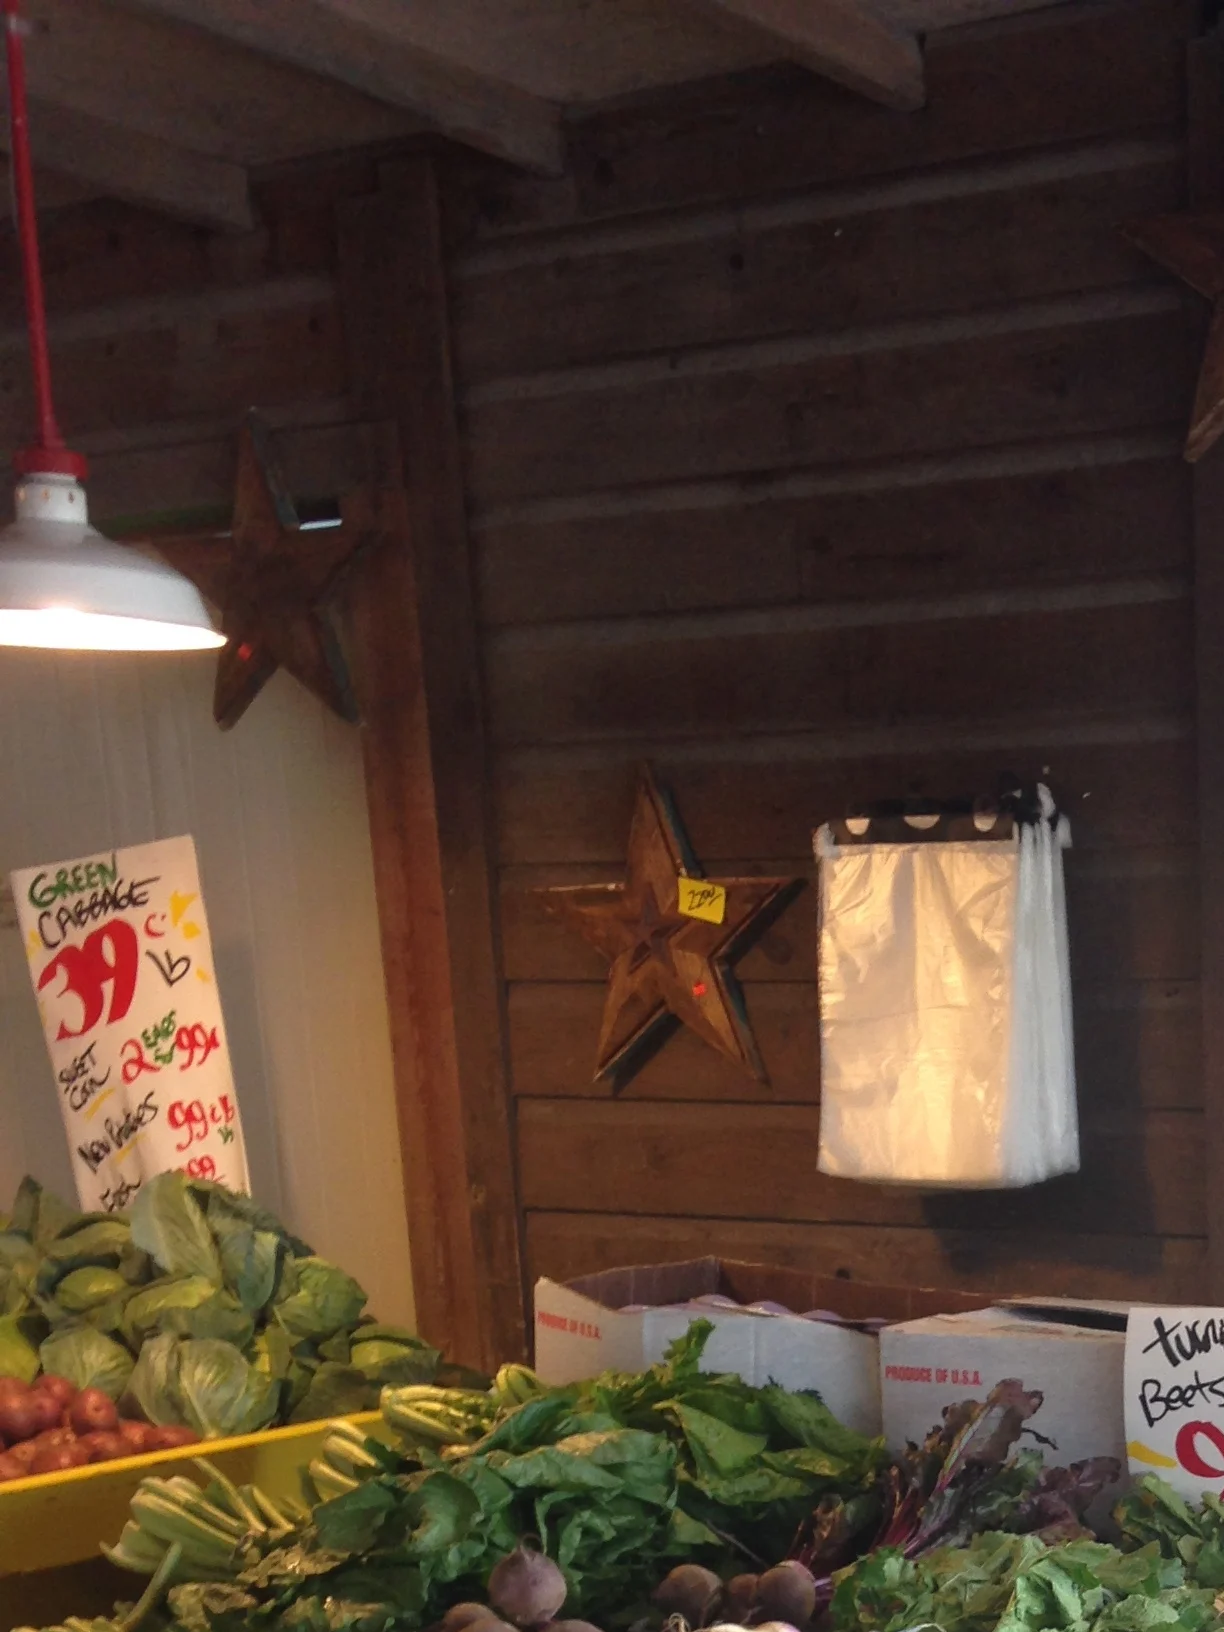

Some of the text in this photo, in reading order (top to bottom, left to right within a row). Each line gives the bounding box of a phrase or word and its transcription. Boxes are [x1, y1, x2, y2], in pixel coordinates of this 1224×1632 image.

[28, 852, 117, 909] GREEN
[38, 875, 161, 950] CABBAGE
[120, 1038, 161, 1086] 2
[885, 1365, 983, 1386] PRODUCE OF U.S.A.
